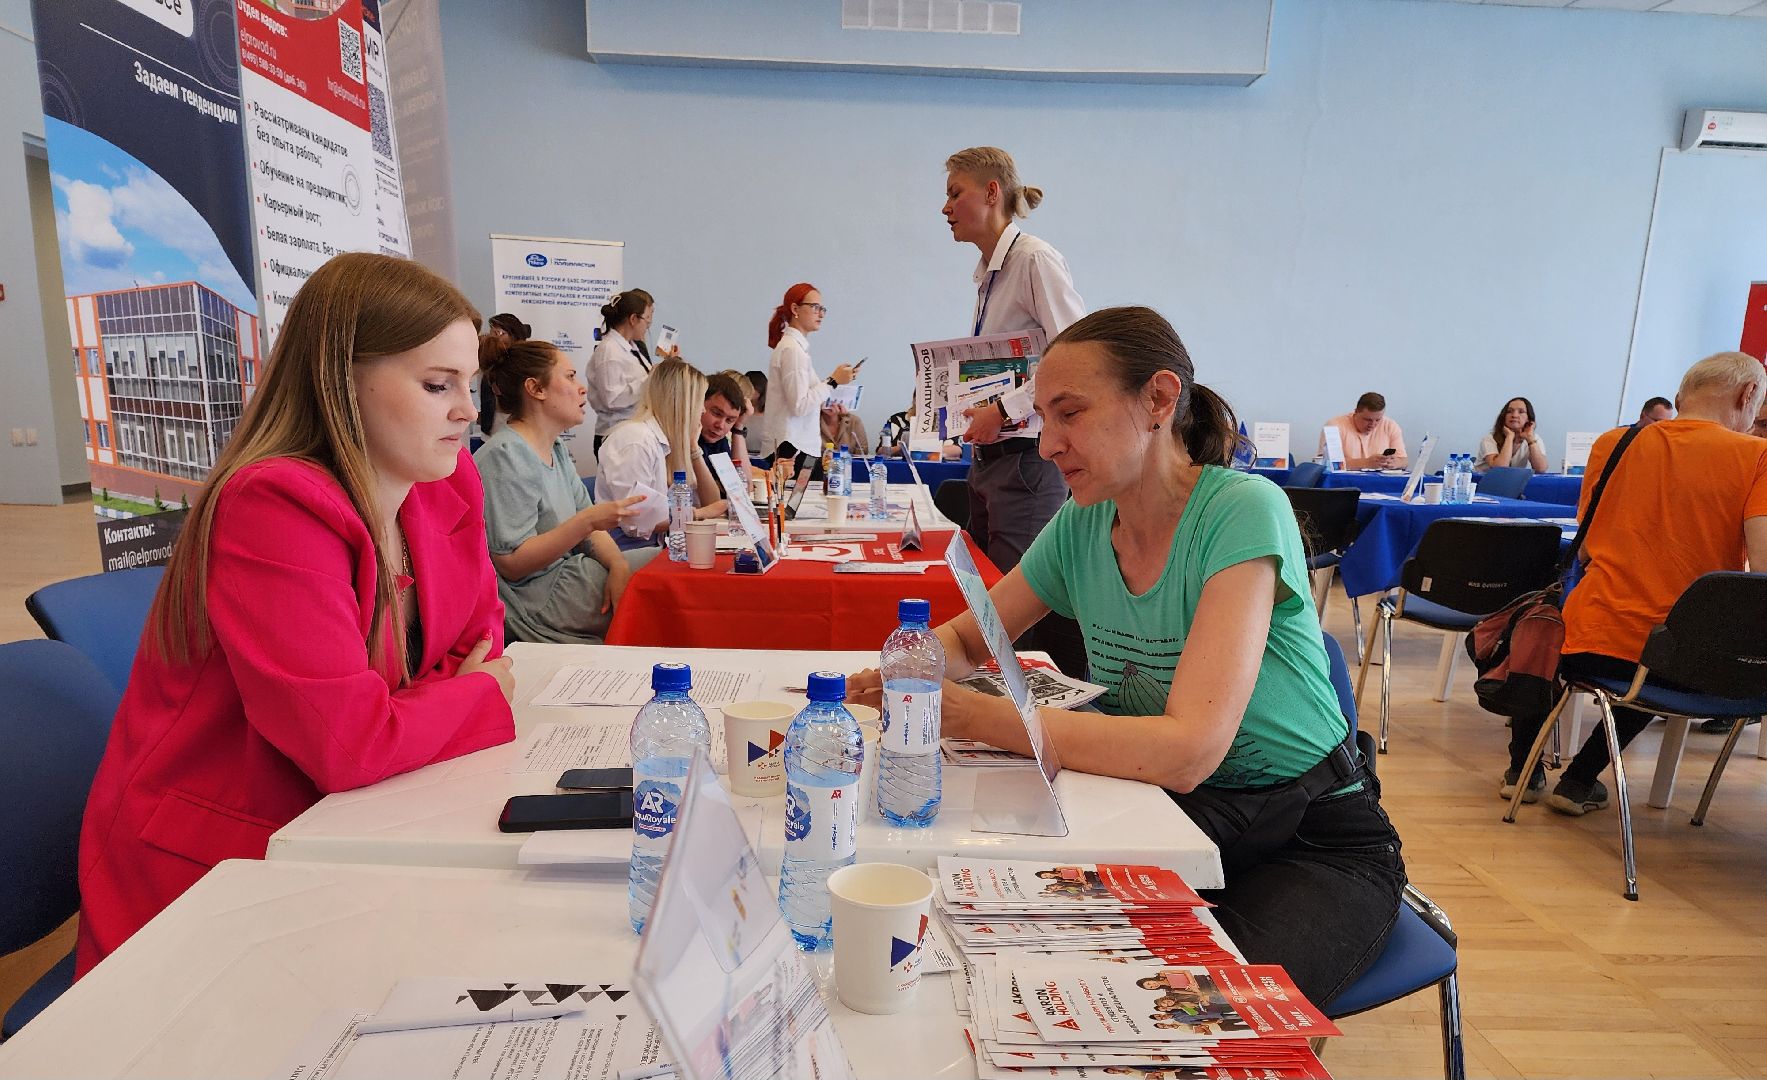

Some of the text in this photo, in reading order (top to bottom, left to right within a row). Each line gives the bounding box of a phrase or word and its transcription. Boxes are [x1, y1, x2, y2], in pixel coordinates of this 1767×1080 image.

[260, 11, 288, 37] кадров:
[240, 27, 277, 59] elprovod.ru
[134, 60, 238, 124] Задаем тенденции
[254, 101, 348, 157] Рассматриваем кандидатов
[256, 125, 323, 168] без опыта работы;
[259, 159, 295, 185] Обучение
[296, 176, 305, 189] на
[263, 192, 322, 227] Карьерный рост;
[266, 225, 334, 256] Белая зарплата. Без
[921, 348, 932, 433] КАЛАШНИКОВ
[103, 523, 156, 545] Контакты:
[1034, 988, 1057, 1016] AKRON
[1044, 980, 1071, 1016] HOLDING
